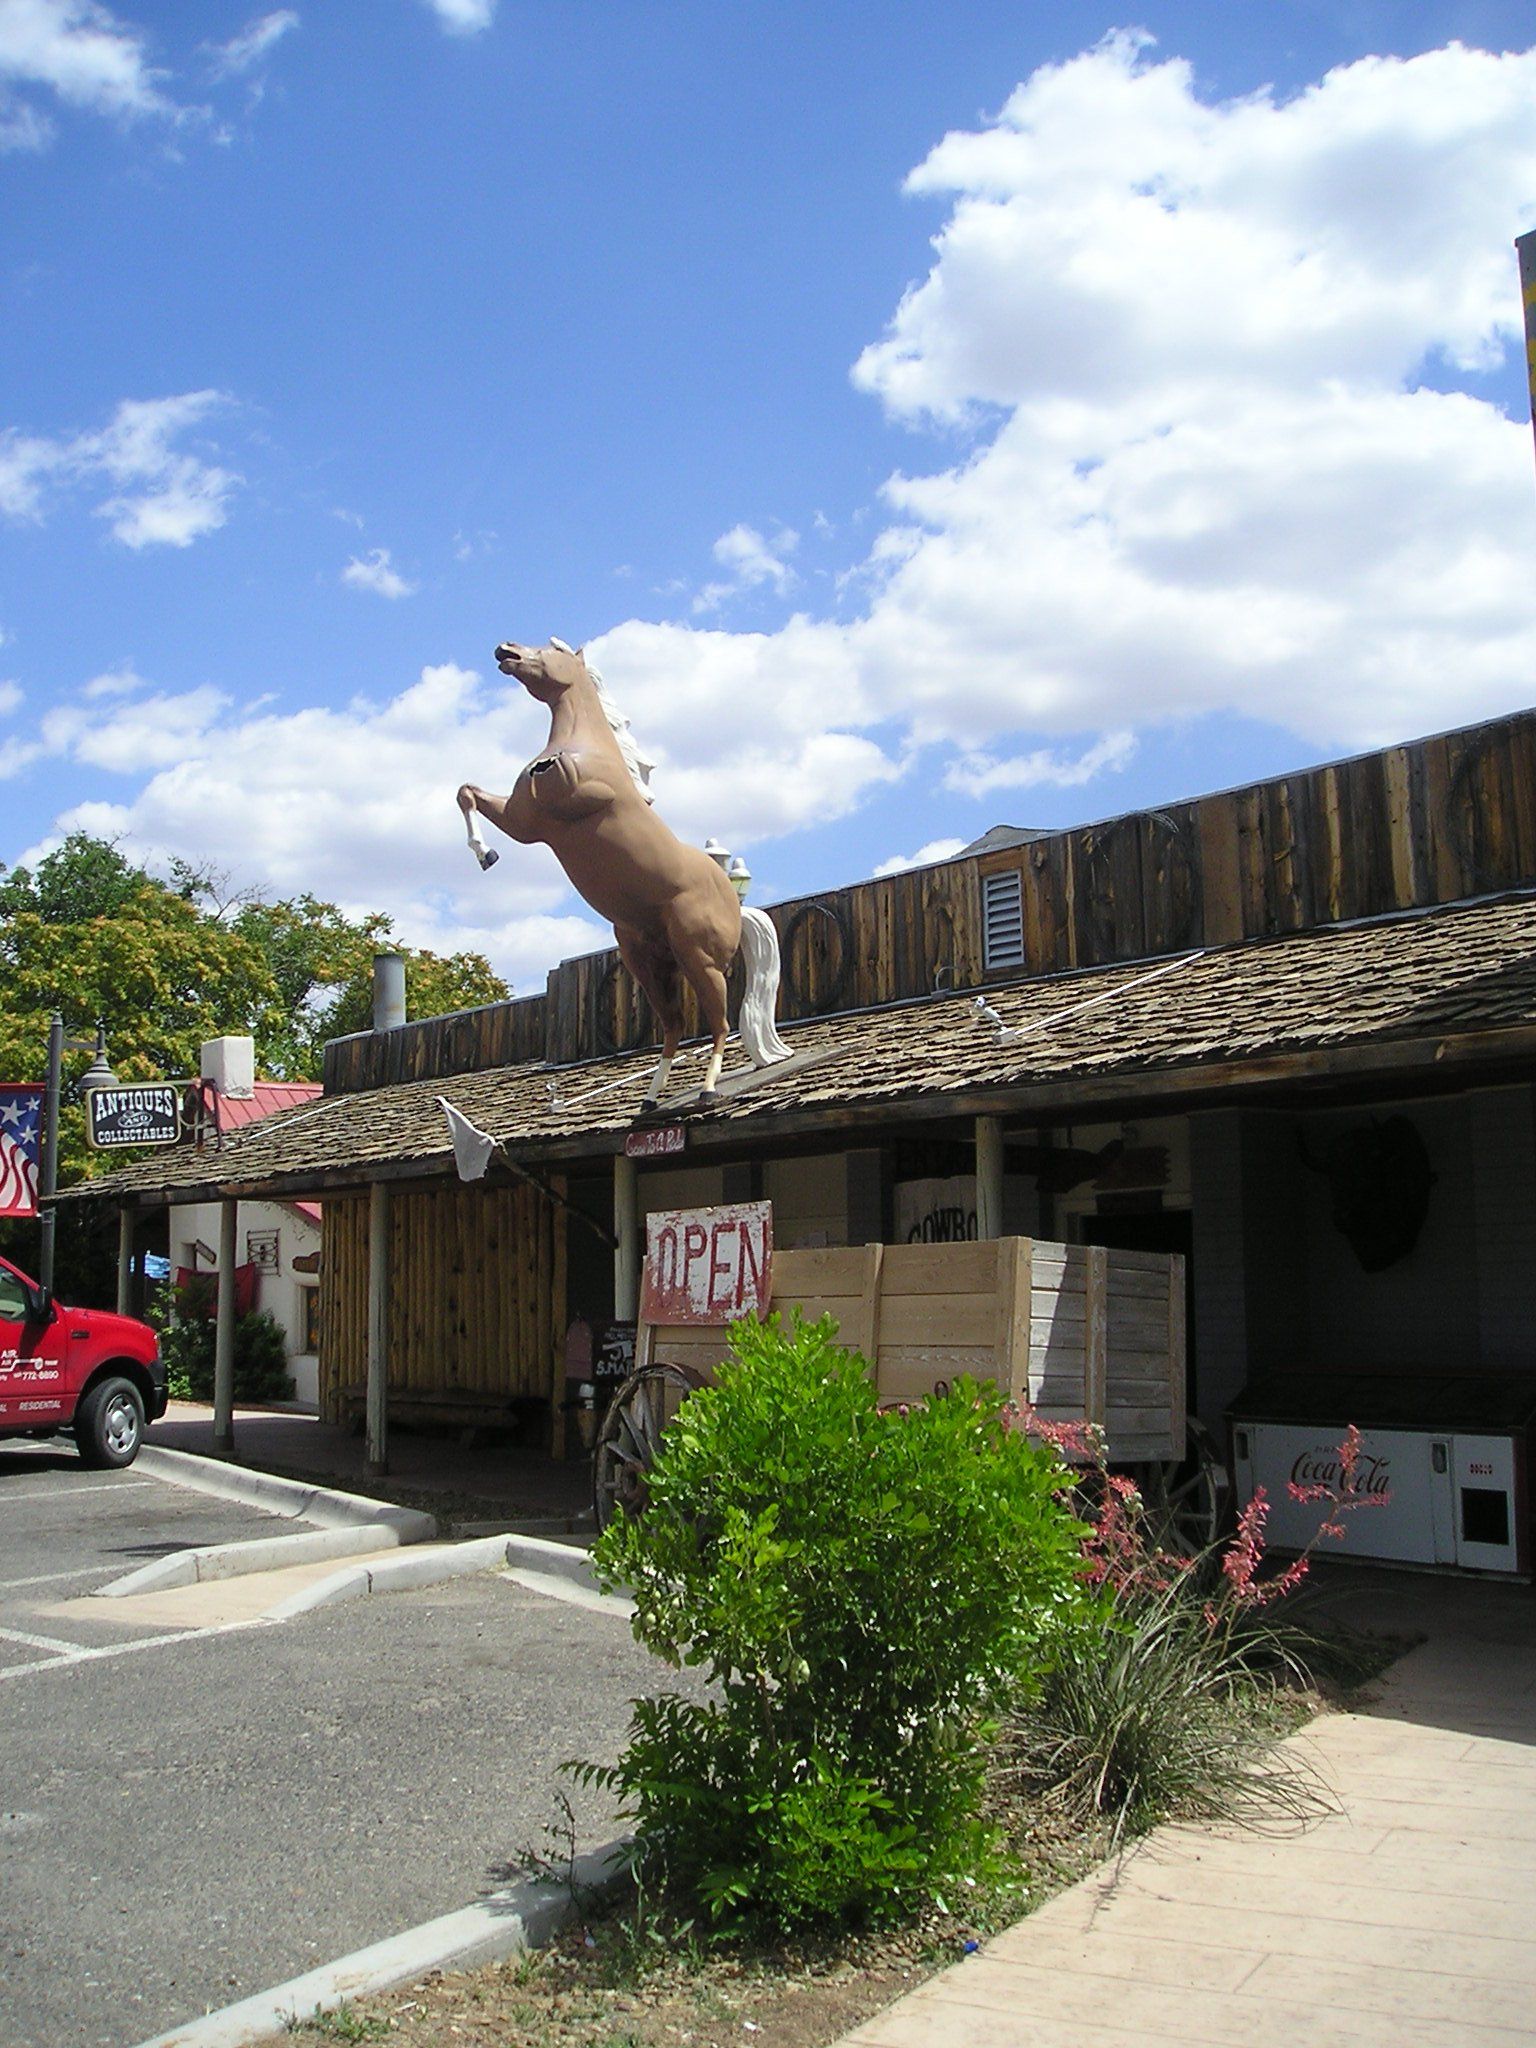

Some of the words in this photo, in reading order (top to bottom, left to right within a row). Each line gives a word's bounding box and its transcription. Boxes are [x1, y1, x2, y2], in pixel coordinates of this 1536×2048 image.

[96, 1089, 173, 1122] ANTIQUES
[124, 1115, 149, 1126] AND
[97, 1126, 175, 1143] COLLECTABLES
[905, 1207, 977, 1243] COWBO
[656, 1220, 768, 1309] OPEN
